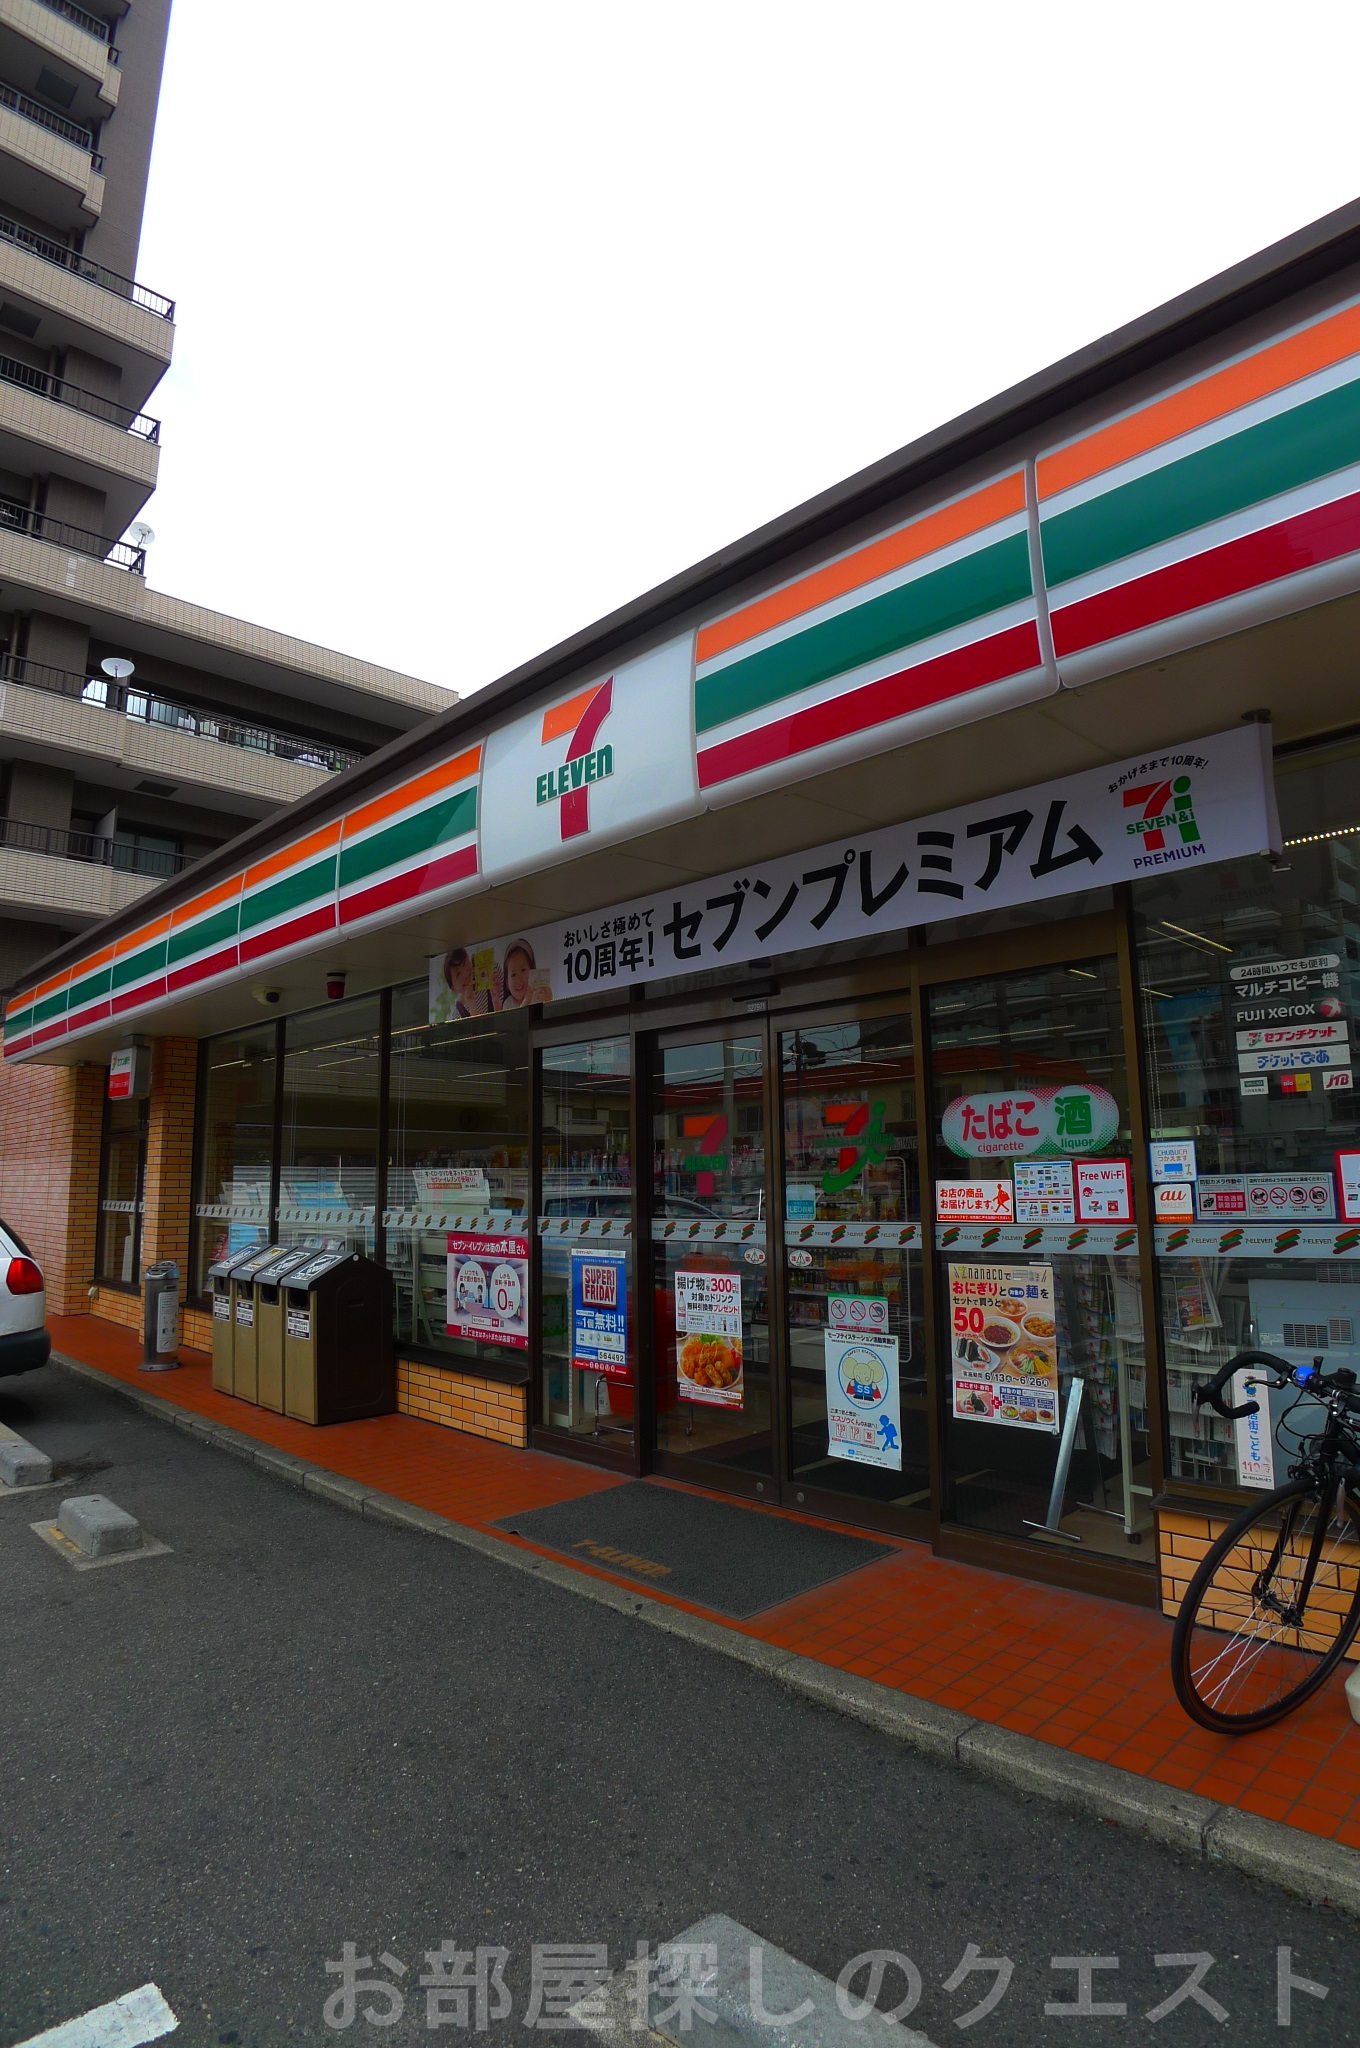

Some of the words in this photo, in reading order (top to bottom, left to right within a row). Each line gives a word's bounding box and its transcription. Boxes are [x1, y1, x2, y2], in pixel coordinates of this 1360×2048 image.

[1133, 843, 1206, 869] PREMIUM
[663, 800, 1104, 960] セブンプレミアム
[563, 908, 656, 949] おいしさ極めて
[562, 932, 656, 984] 10周年!
[1240, 957, 1328, 977] 24時間いつでも便利
[1234, 971, 1340, 998] マルチコピー機
[1236, 1009, 1265, 1022] FUJI
[1263, 1026, 1337, 1043] セブンチケット
[961, 1099, 1040, 1142] たばこ
[1054, 1095, 1092, 1136] 酒
[977, 1142, 1024, 1154] cigarette
[1061, 1138, 1095, 1149] liquor
[1080, 1171, 1099, 1180] Free
[1100, 1170, 1125, 1180] Wi-Fi
[940, 1188, 984, 1199] お店の商品
[1160, 1190, 1187, 1201] au
[585, 1284, 615, 1302] FRIDAY
[691, 1292, 734, 1304] 対象のドリンク
[953, 1296, 1002, 1307] セットで買うと
[953, 1306, 985, 1333] 50
[856, 1384, 871, 1395] SS
